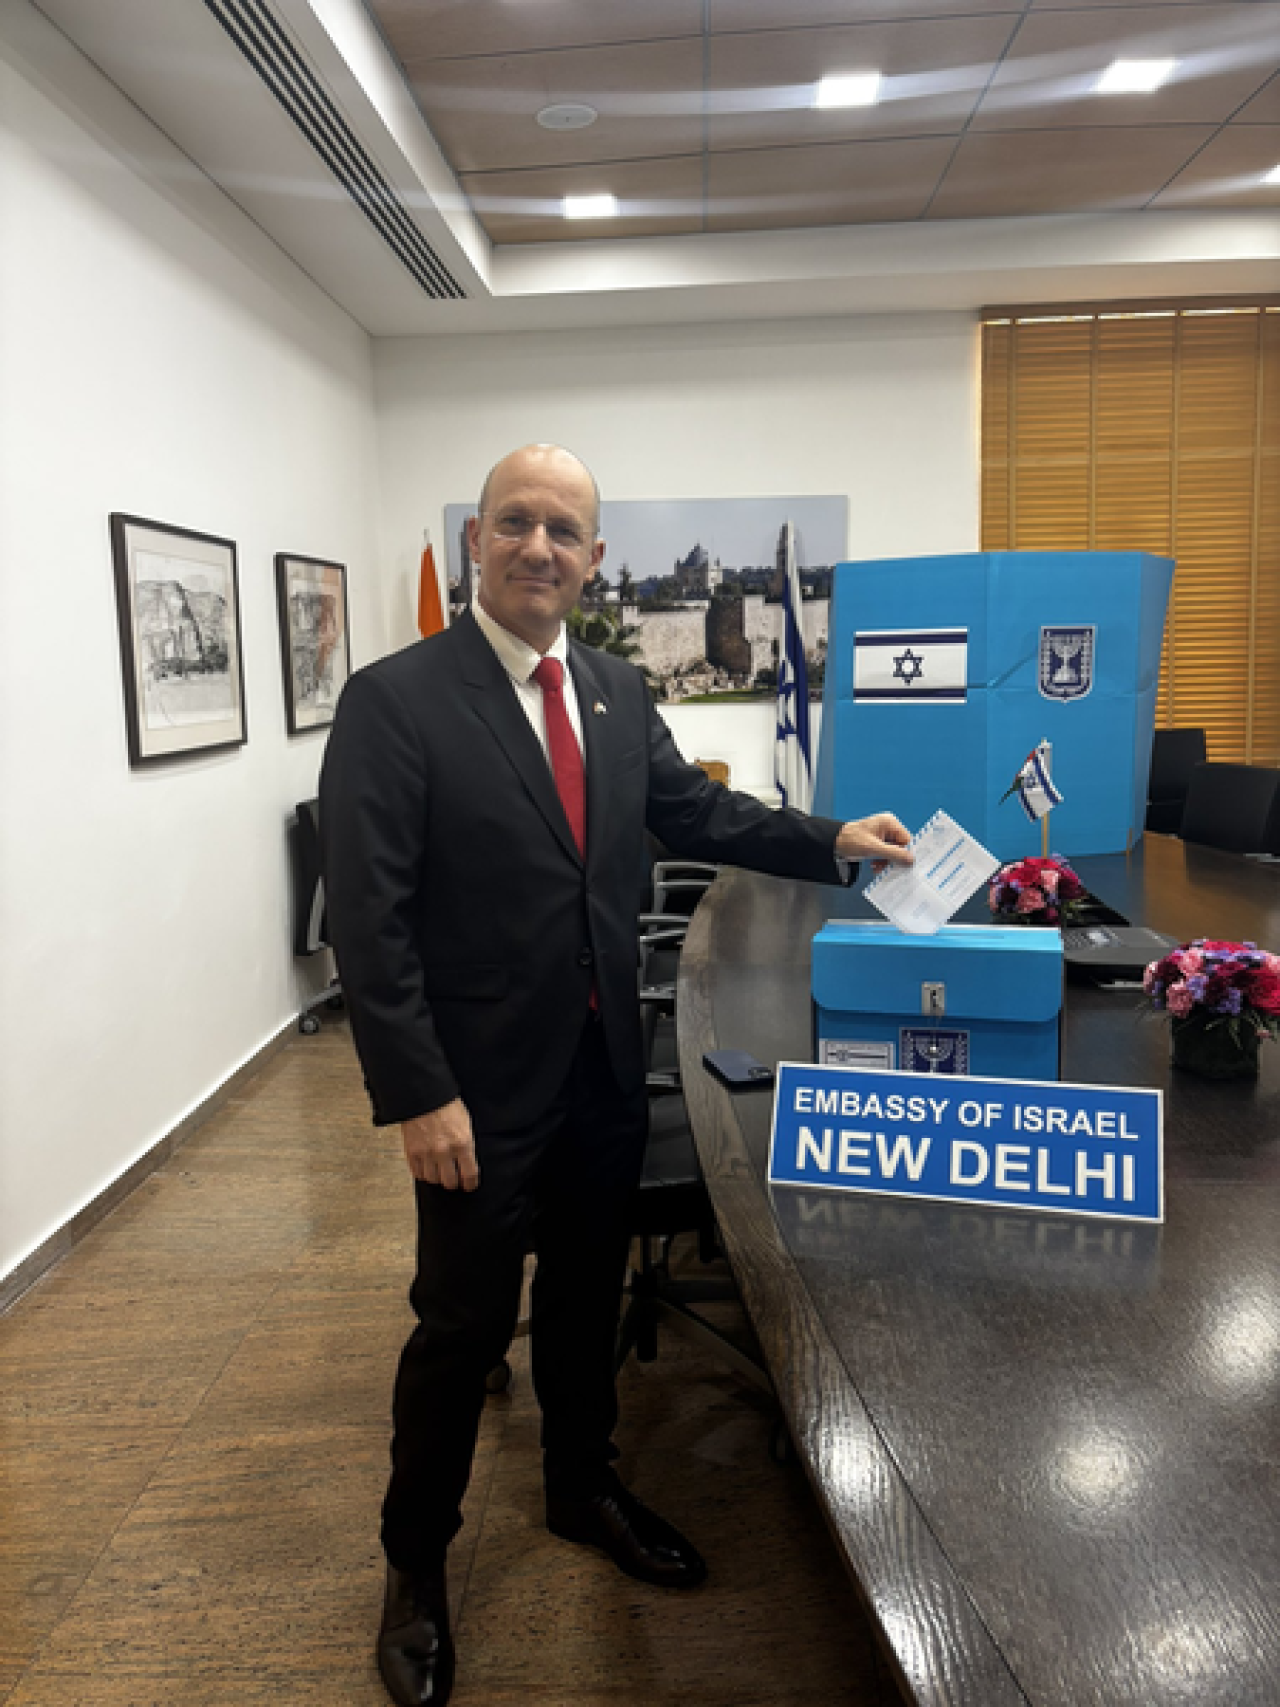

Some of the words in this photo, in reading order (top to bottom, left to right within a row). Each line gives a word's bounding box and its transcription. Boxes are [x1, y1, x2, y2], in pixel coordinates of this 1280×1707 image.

[793, 1086, 950, 1124] EMBASSY
[957, 1101, 1004, 1128] OF
[1013, 1104, 1139, 1140] ISRAEL
[795, 1126, 932, 1182] NEW
[950, 1139, 1135, 1202] DELHI
